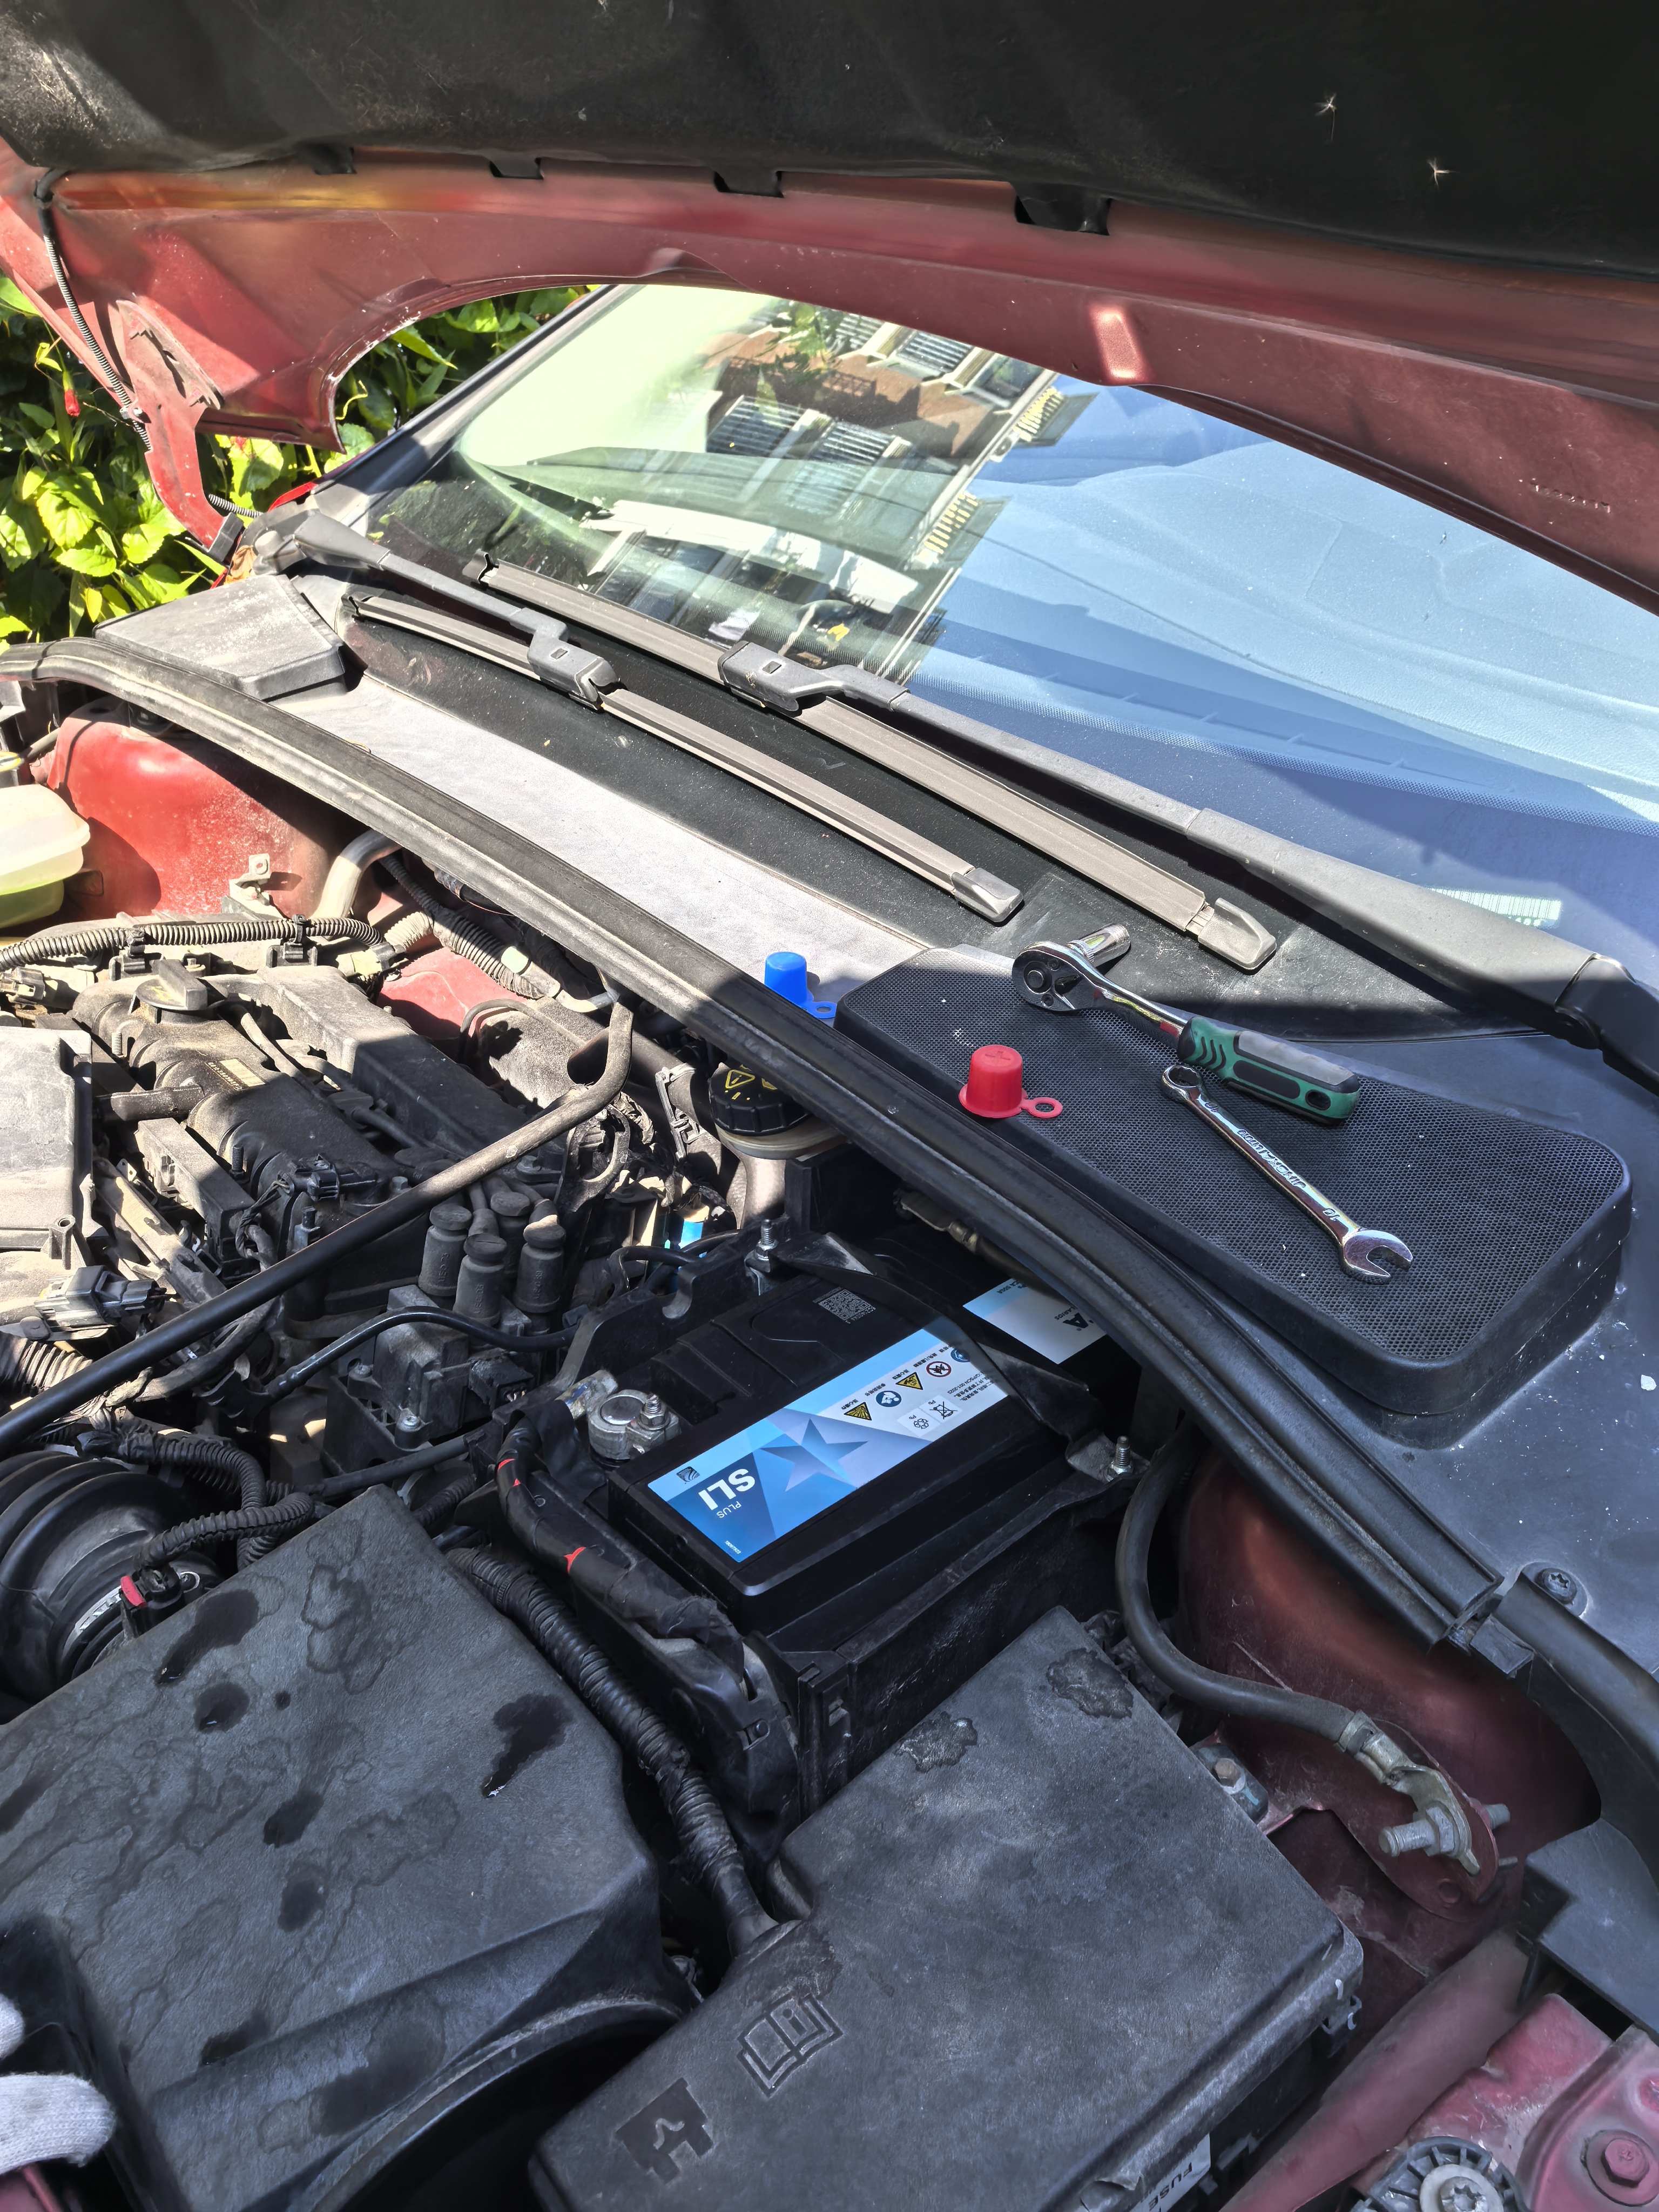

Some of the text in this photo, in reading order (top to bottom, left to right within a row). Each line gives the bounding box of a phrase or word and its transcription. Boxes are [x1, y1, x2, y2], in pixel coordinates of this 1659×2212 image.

[698, 1468, 756, 1510] SLI
[716, 1501, 742, 1519] PLUS
[1148, 2162, 1192, 2212] FUSE
